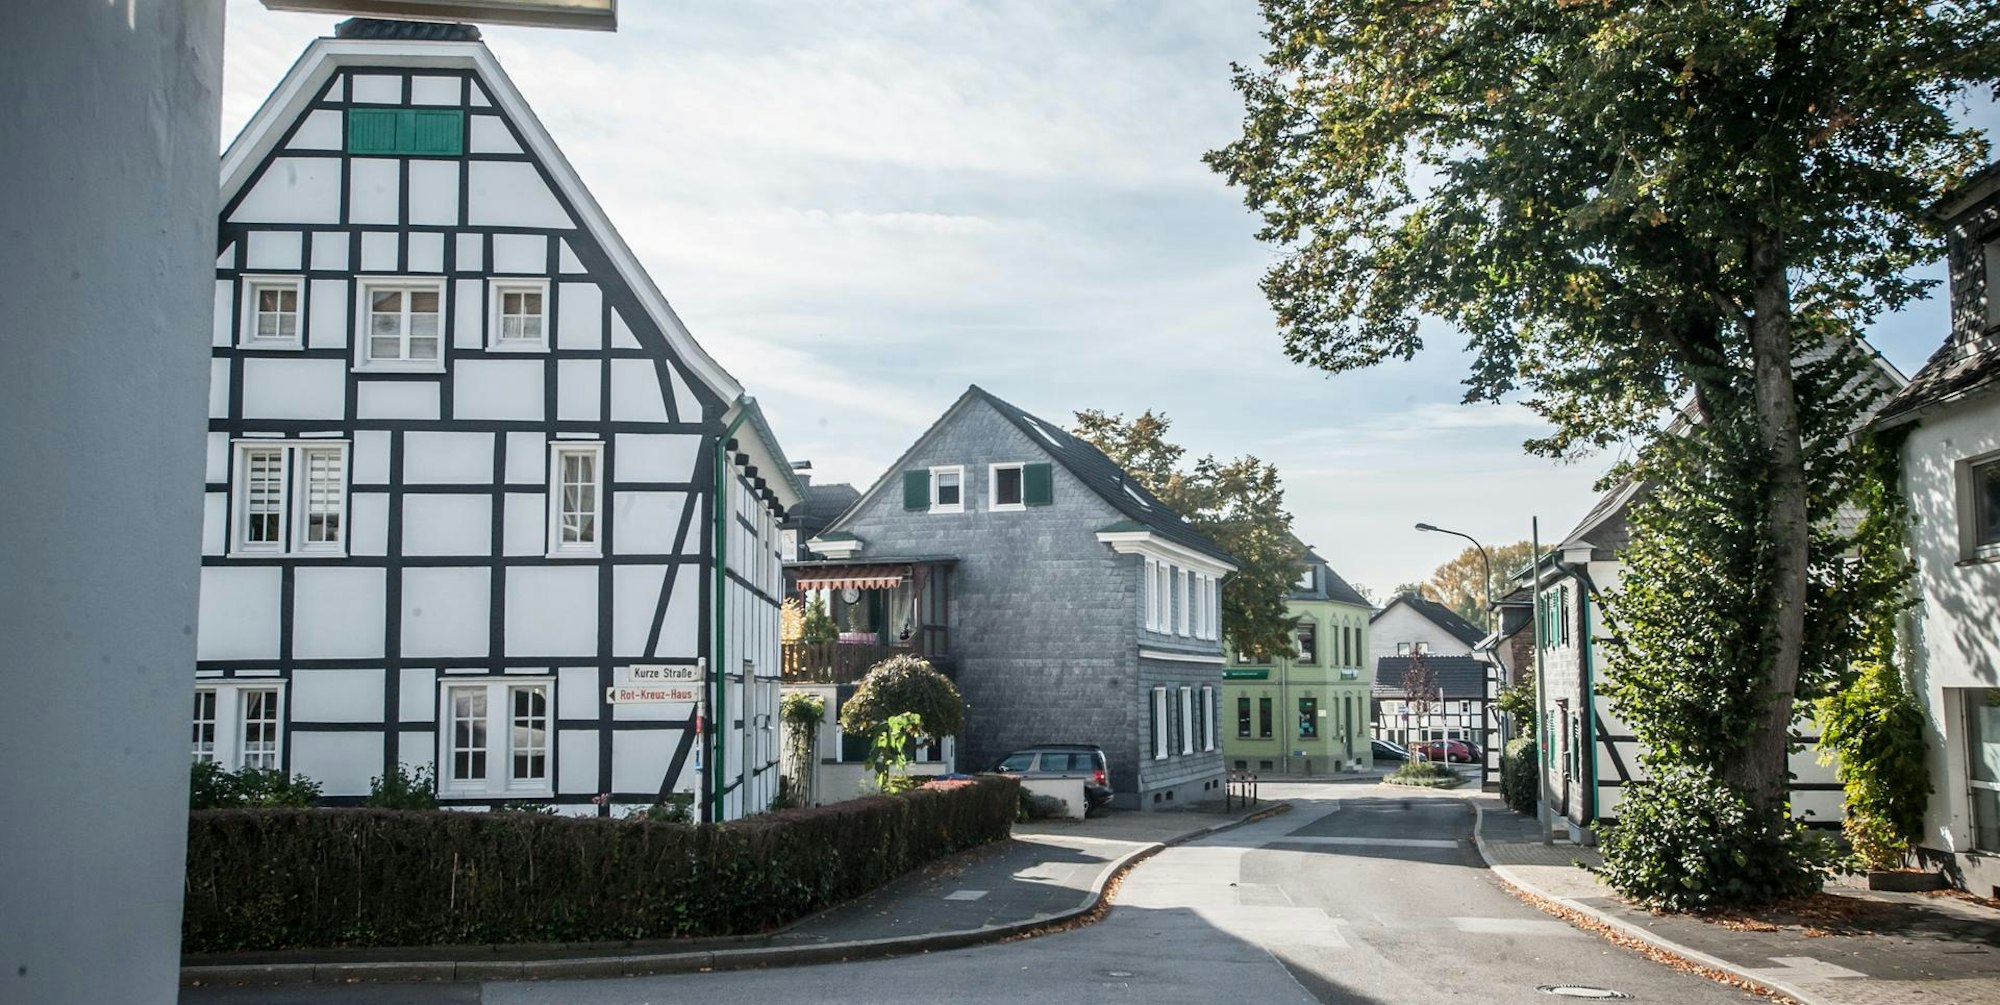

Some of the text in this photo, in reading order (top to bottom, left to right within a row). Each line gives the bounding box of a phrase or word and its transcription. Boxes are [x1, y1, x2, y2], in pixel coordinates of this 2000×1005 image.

[634, 667, 692, 678] Kurze Straße
[620, 689, 692, 700] Rot-Kreuz-Haus
